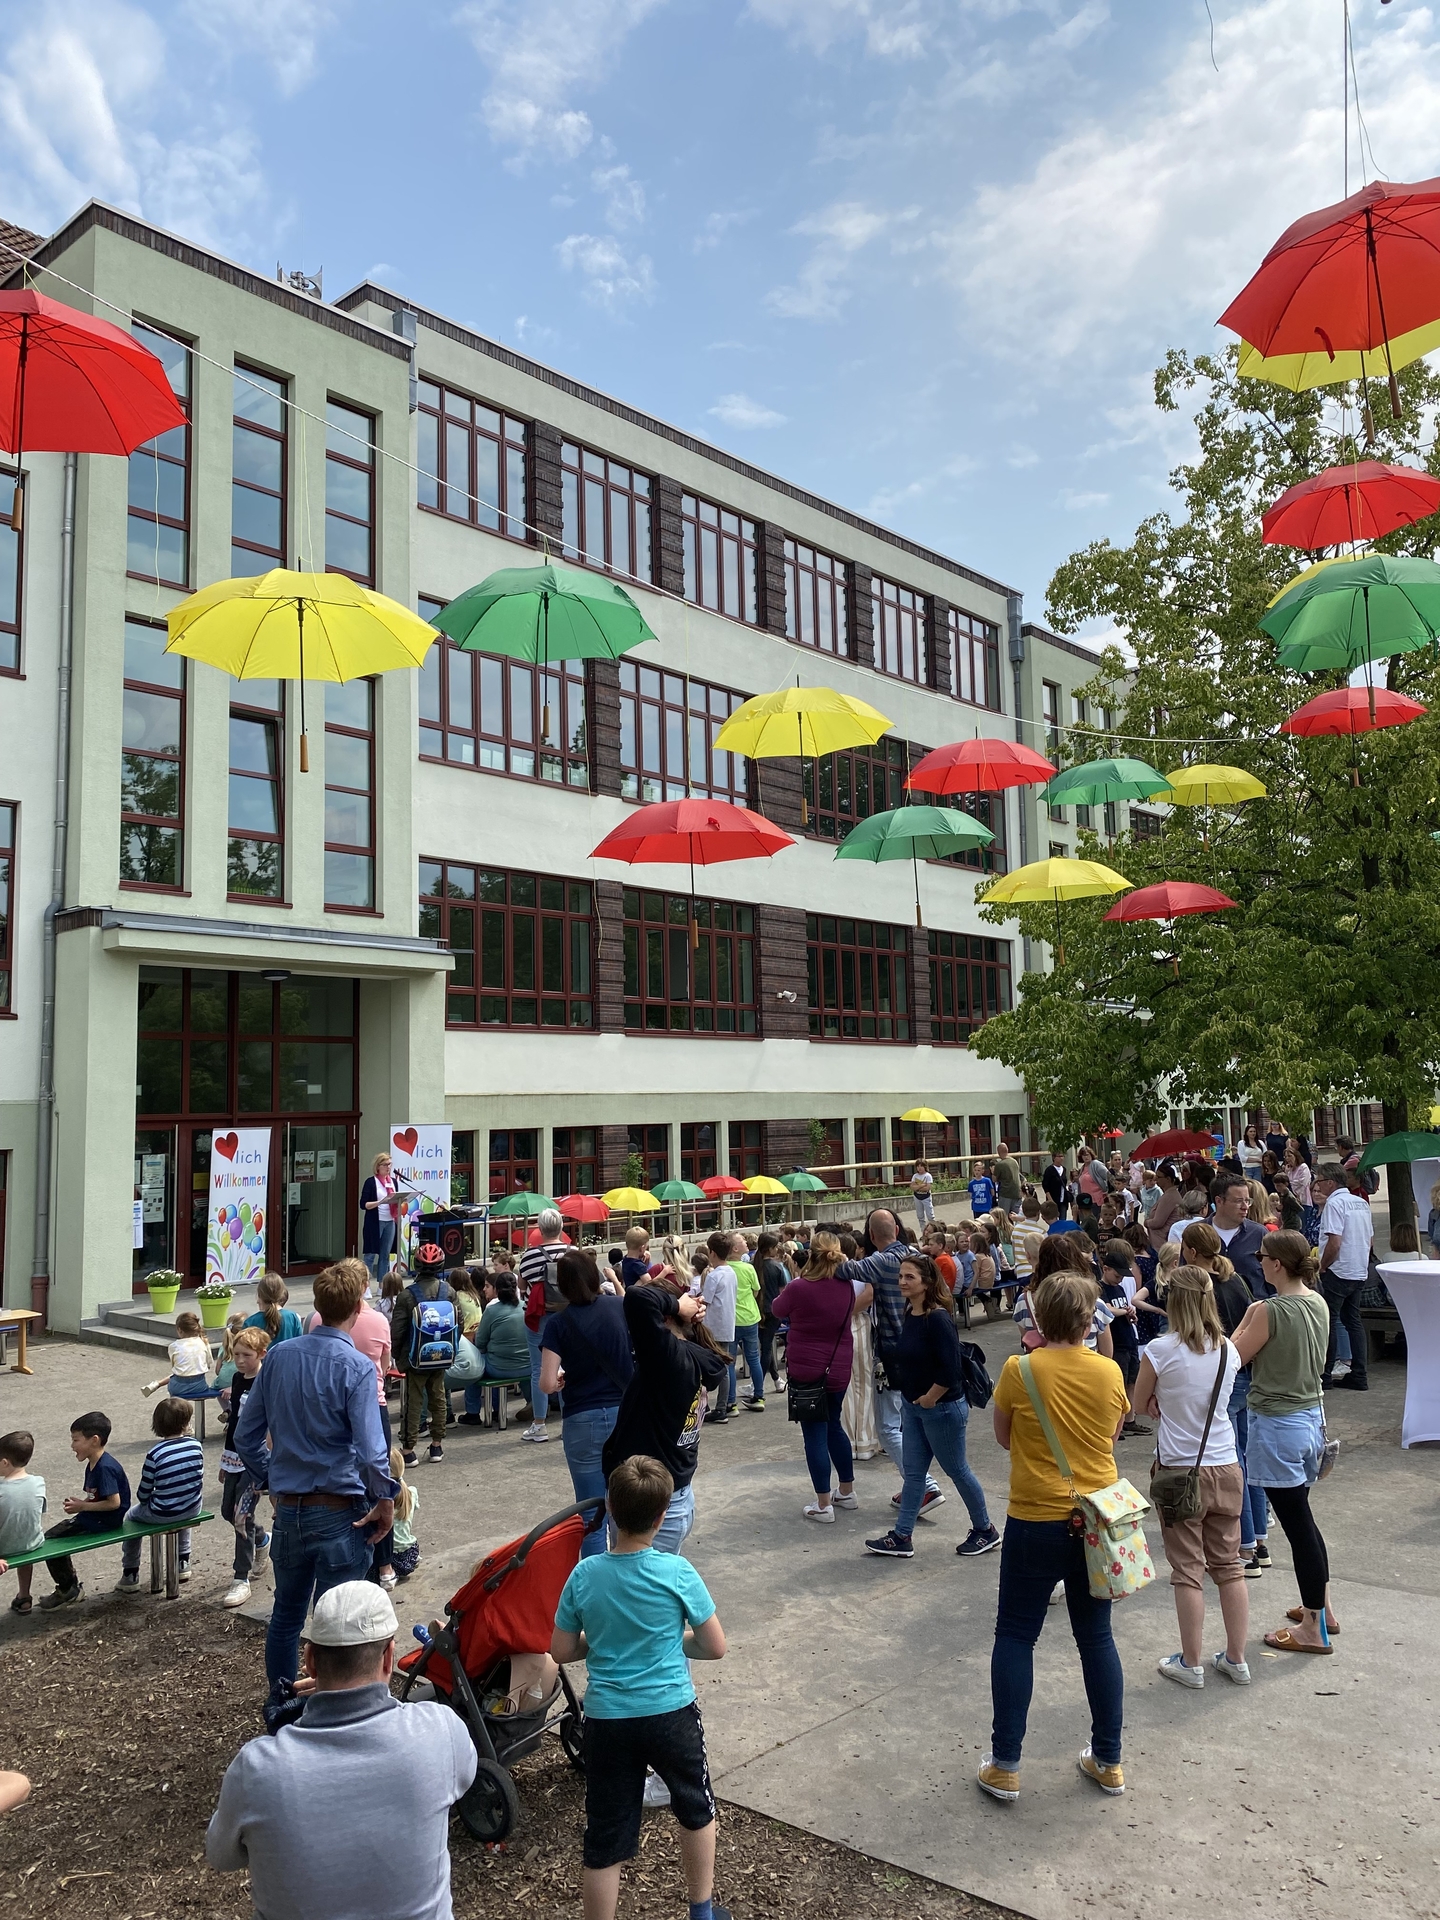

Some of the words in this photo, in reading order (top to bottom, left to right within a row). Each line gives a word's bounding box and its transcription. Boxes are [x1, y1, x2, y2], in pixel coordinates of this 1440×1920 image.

[236, 1149, 262, 1164] lich
[416, 1144, 443, 1158] lich
[214, 1172, 266, 1189] Willkommen
